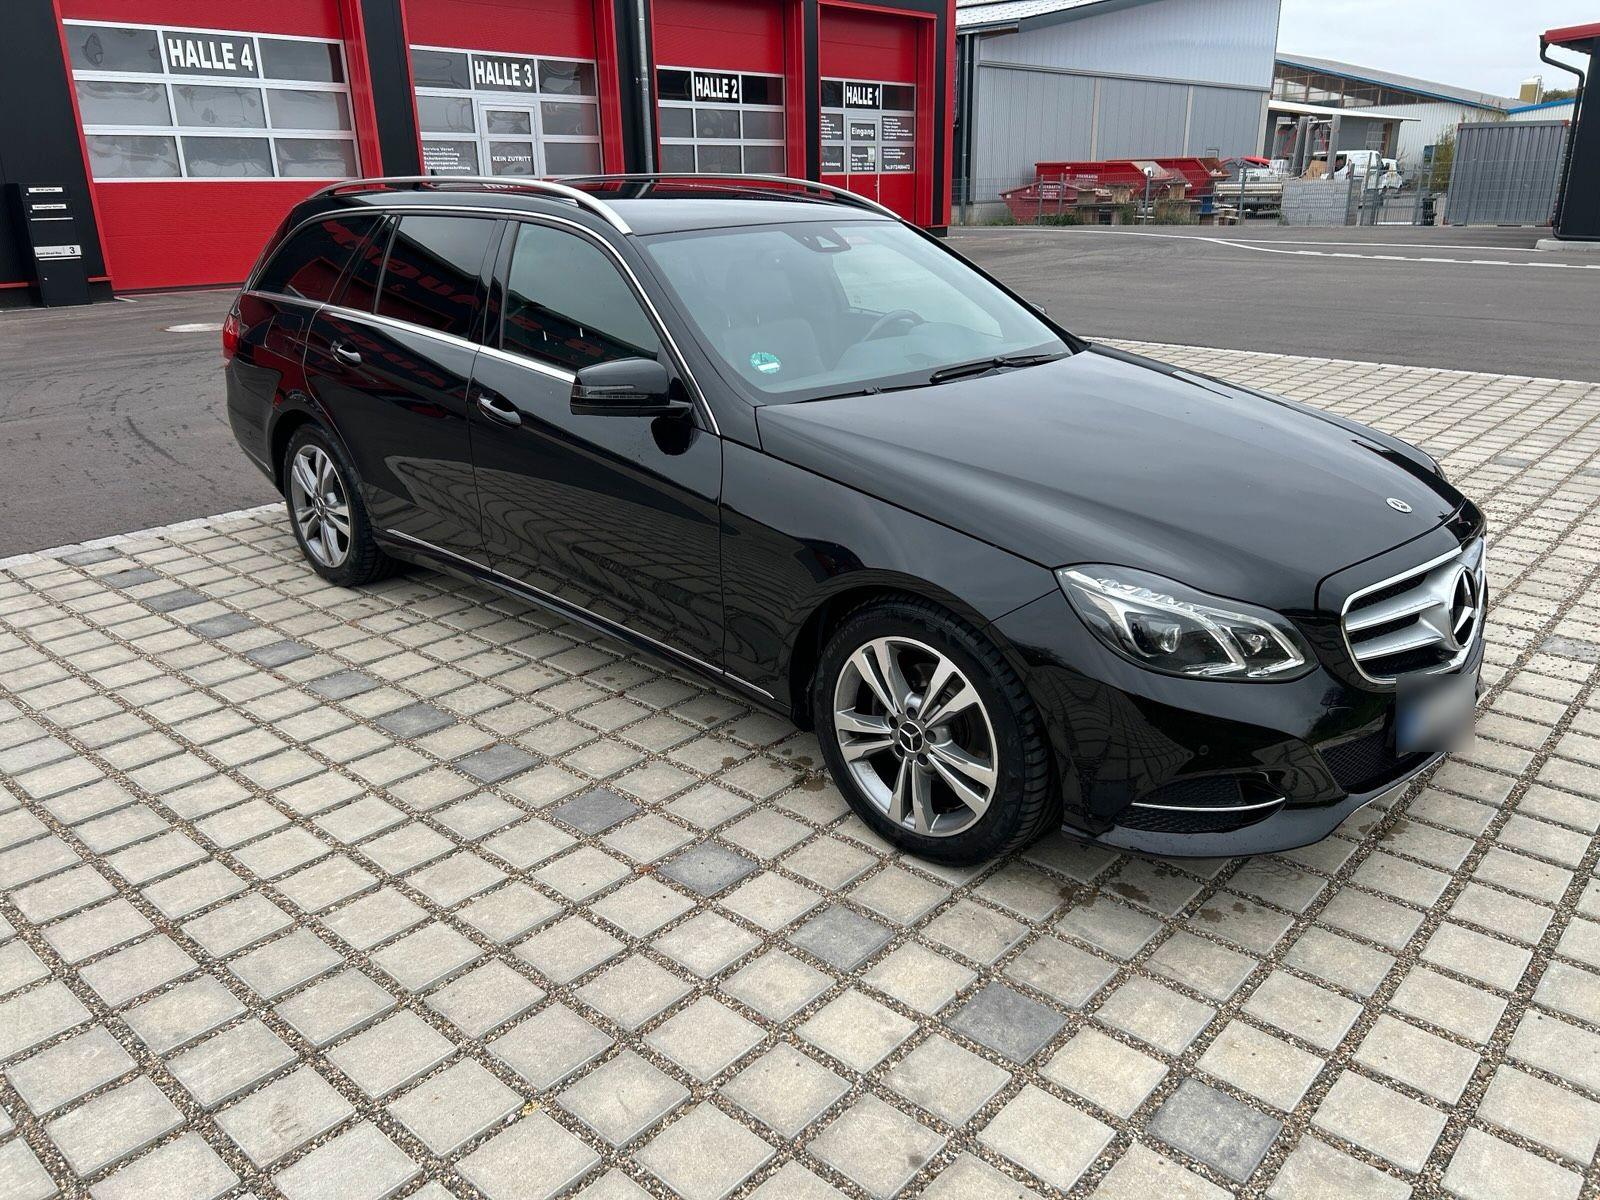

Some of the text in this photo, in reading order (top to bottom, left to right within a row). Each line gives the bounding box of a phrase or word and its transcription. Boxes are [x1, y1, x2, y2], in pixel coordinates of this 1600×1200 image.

[167, 38, 254, 72] HALLE 4
[474, 60, 533, 88] HALLE 3
[695, 76, 738, 99] HALLE 2
[846, 85, 879, 106] HALLE 1
[851, 127, 875, 137] Eingang
[69, 246, 76, 254] 3
